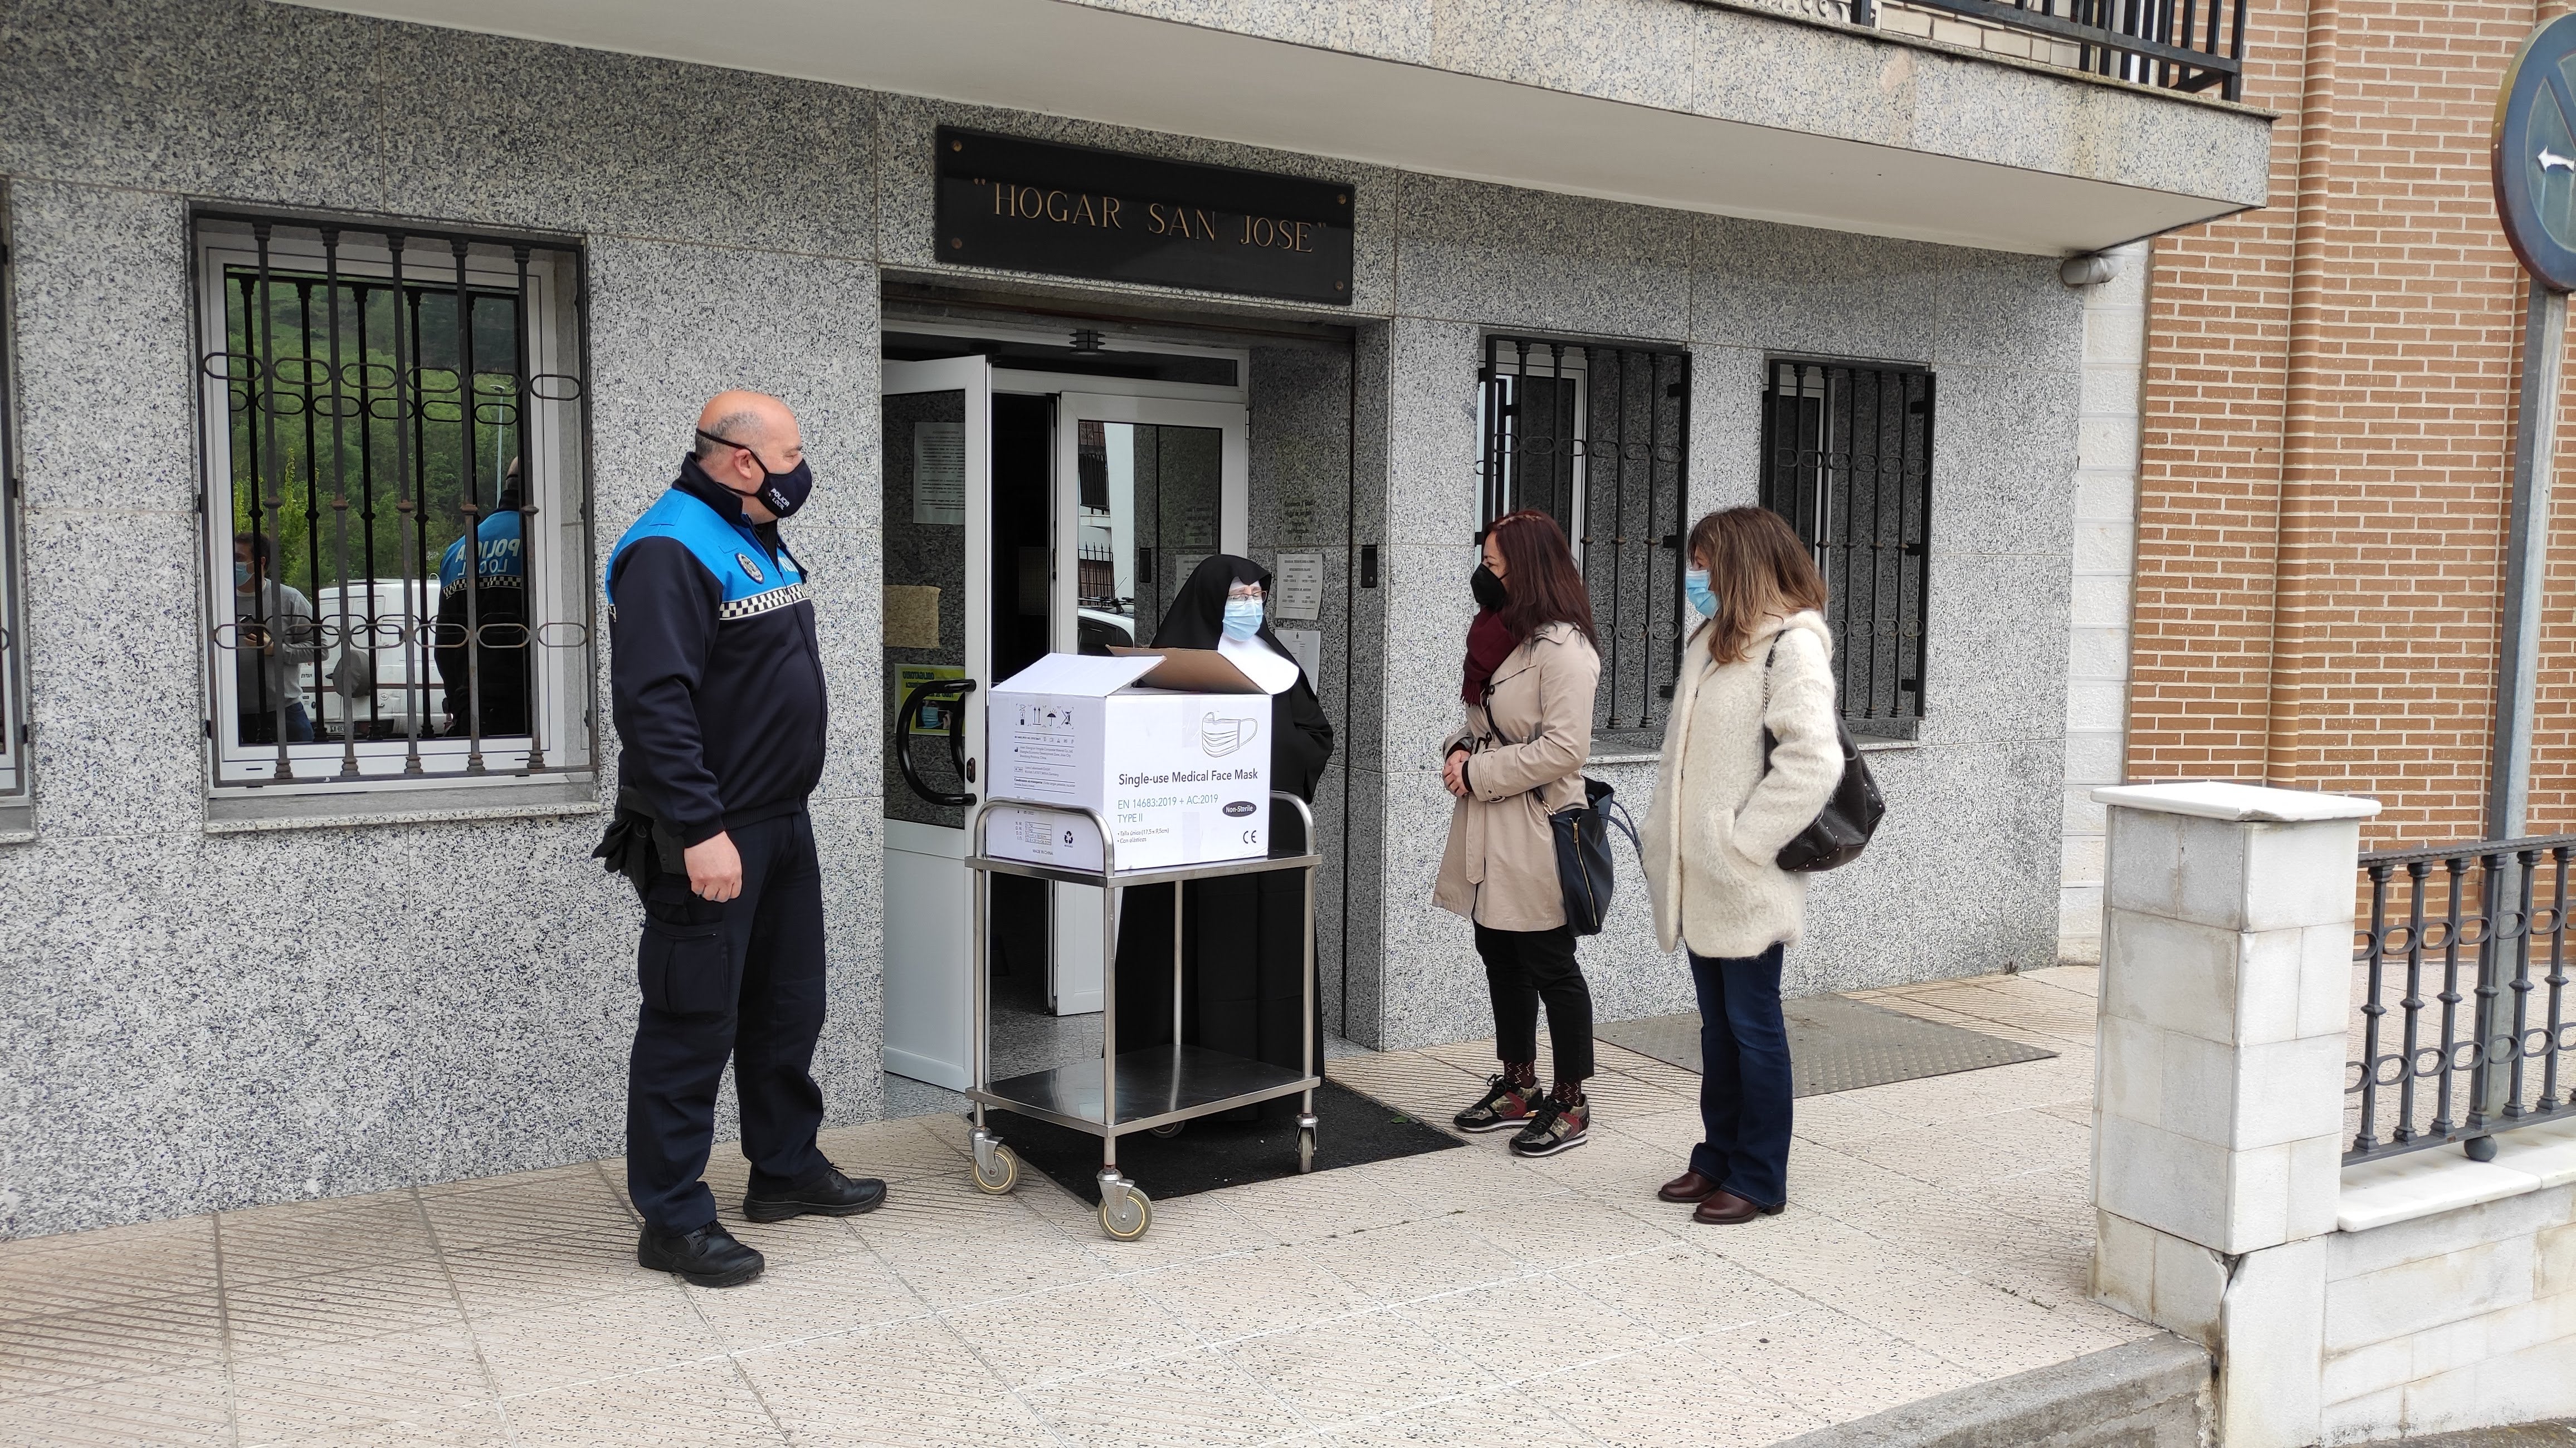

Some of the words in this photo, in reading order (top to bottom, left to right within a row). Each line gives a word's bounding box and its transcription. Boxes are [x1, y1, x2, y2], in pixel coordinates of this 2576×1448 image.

[1148, 203, 1216, 241] SAN
[1119, 772, 1169, 787] Single-use
[1172, 770, 1208, 782] Medical
[1211, 770, 1232, 781] Face
[1235, 768, 1258, 780] Mask
[1118, 800, 1129, 809] EN
[1133, 796, 1177, 809] 14683:2019
[1187, 794, 1218, 805] AC:2019
[1226, 805, 1253, 813] Non-Sterile
[1118, 814, 1137, 823] TYPE
[1138, 813, 1143, 822] II
